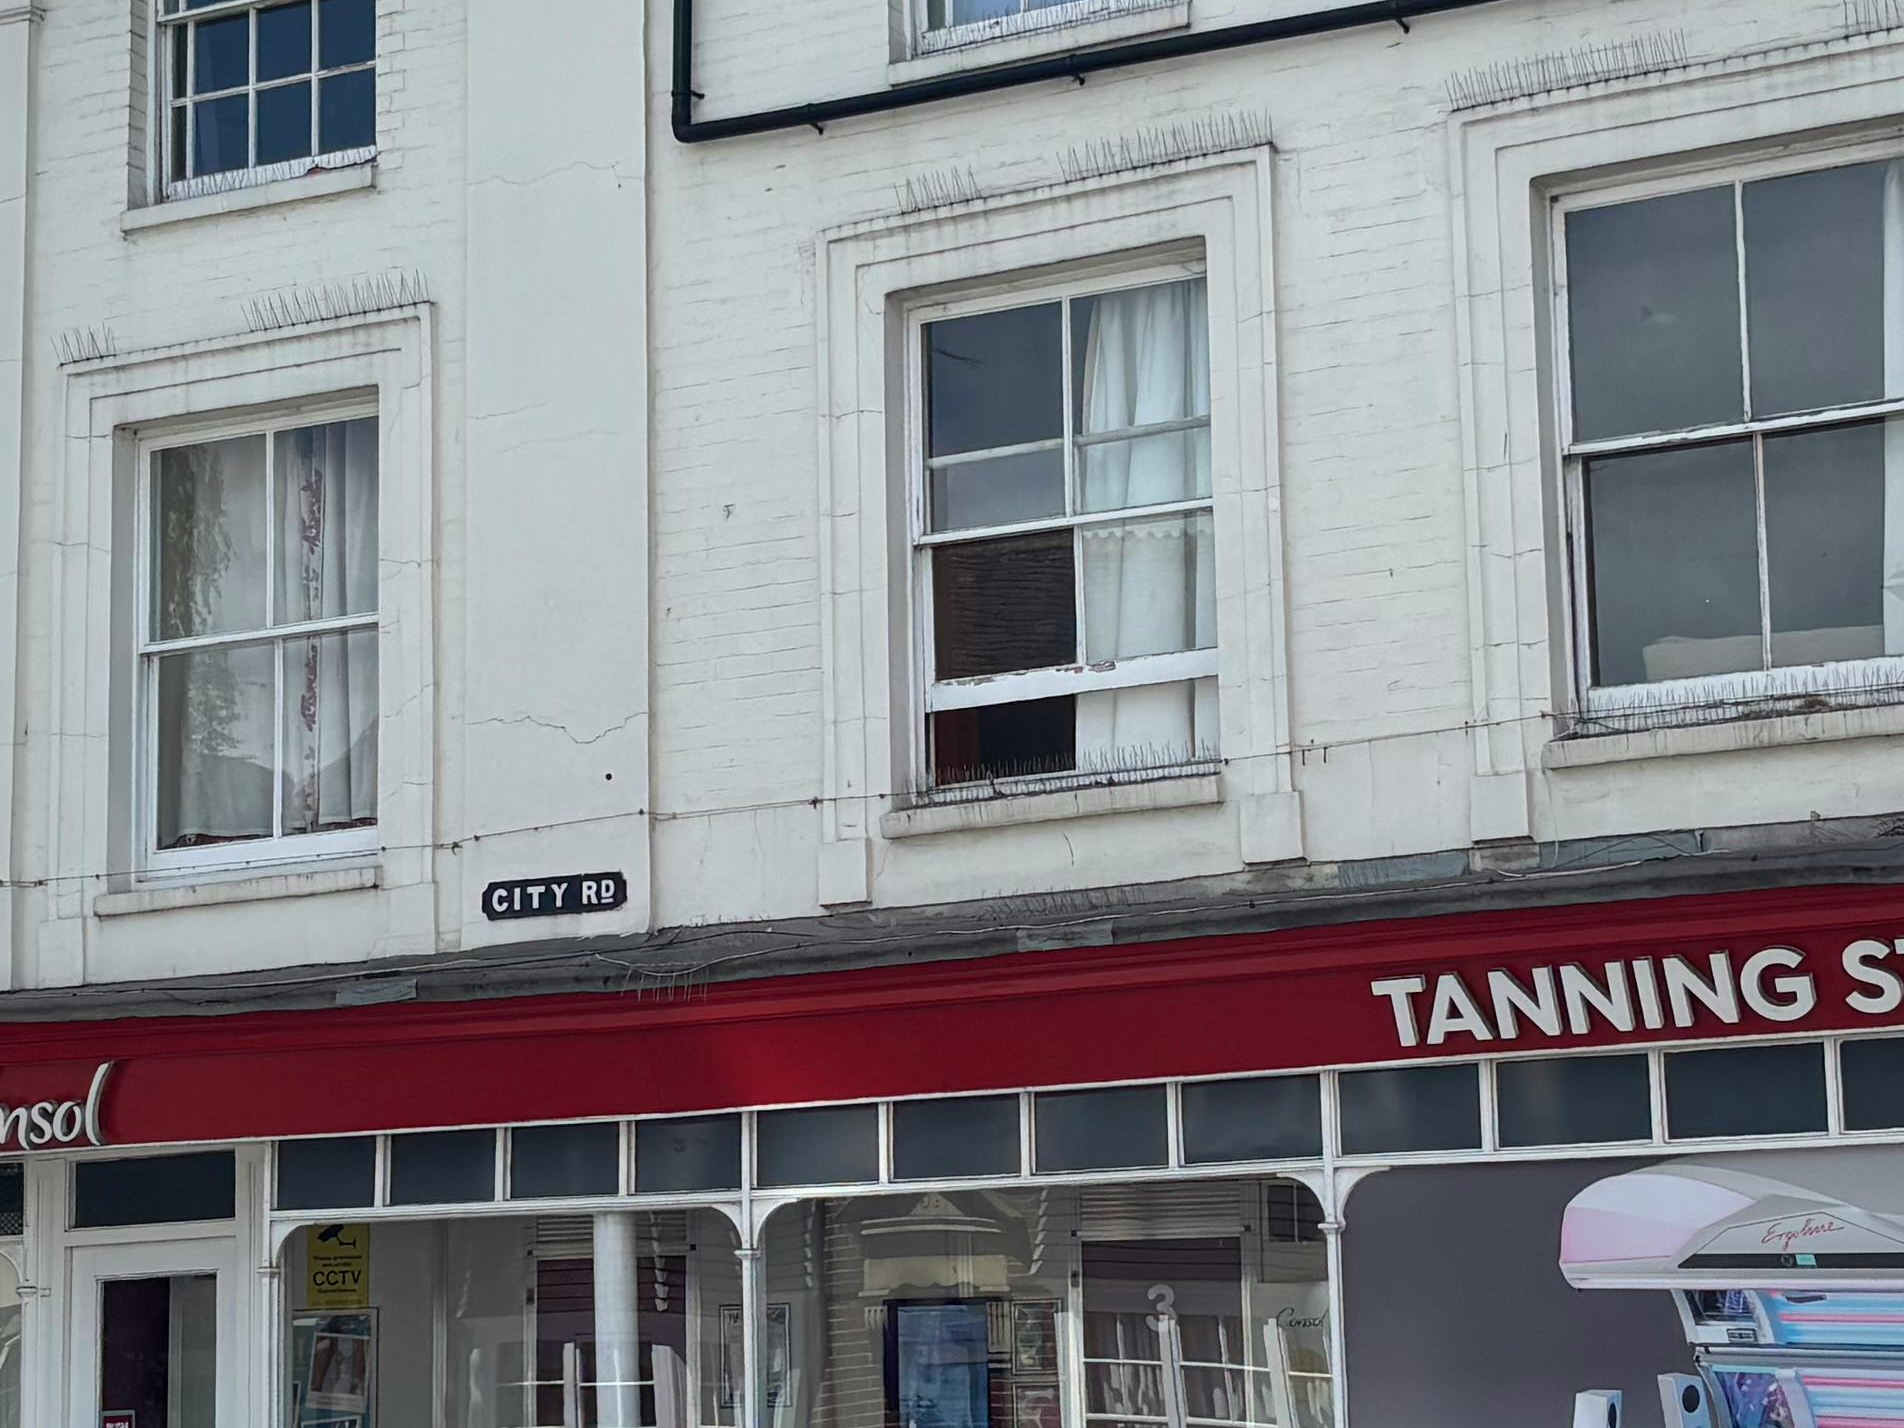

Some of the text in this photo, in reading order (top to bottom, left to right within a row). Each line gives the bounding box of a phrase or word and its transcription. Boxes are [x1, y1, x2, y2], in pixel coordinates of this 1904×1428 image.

[492, 879, 615, 913] CITY RD
[1370, 946, 1818, 1047] TANNING
[313, 1270, 362, 1286] CCTV
